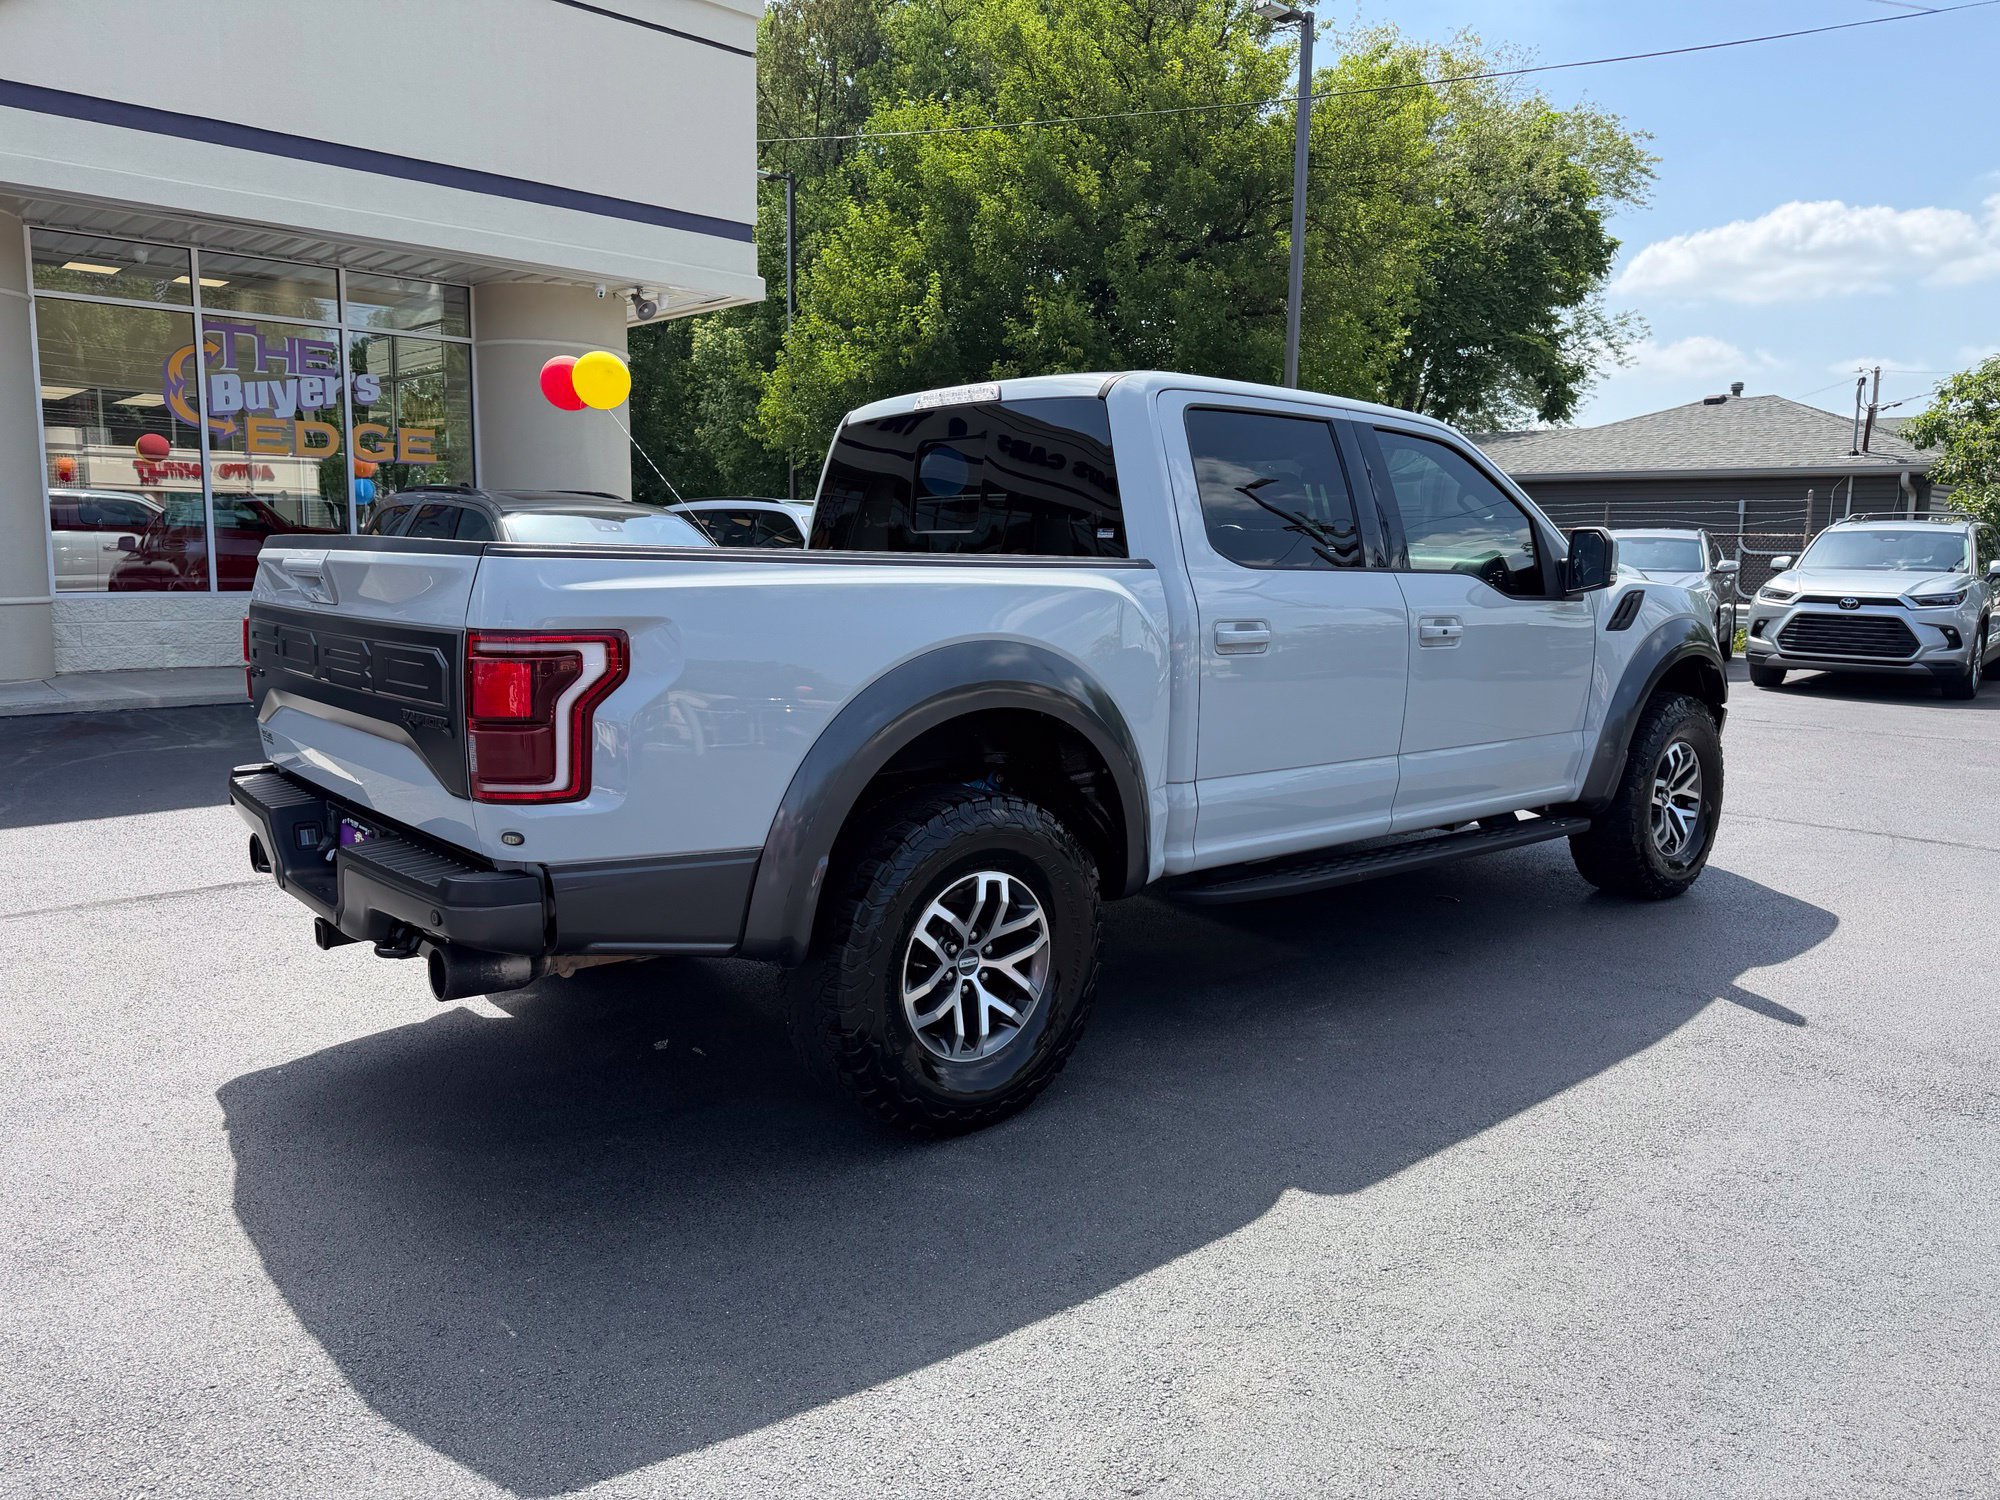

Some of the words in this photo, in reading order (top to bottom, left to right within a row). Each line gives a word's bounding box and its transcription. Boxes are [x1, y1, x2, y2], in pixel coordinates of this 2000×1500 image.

[203, 319, 338, 377] THE
[208, 372, 382, 419] Buyer's
[245, 415, 438, 464] EDGE
[250, 617, 450, 711] FORD
